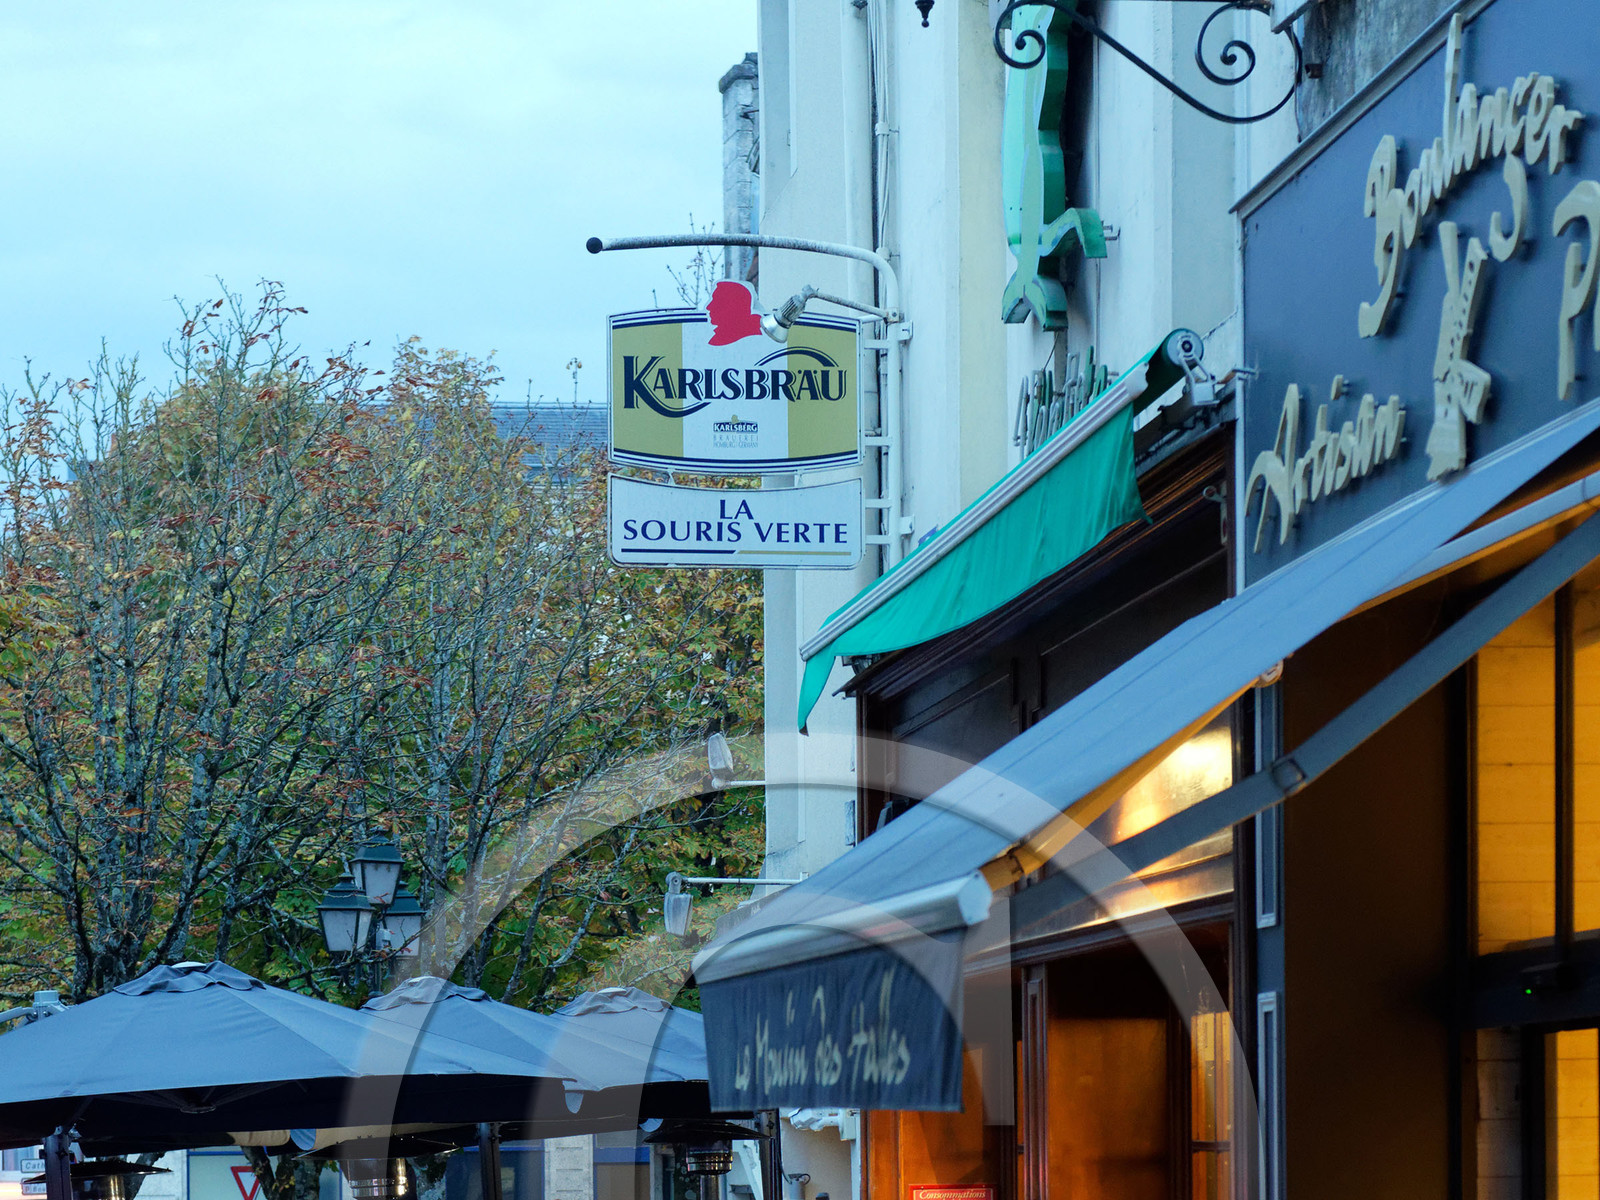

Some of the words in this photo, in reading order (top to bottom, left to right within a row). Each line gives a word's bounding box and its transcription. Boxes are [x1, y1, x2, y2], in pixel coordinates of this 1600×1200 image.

[1358, 12, 1583, 338] Boulanger
[623, 346, 848, 418] KARLSBRÄU
[714, 423, 758, 432] KARLSBERG
[1245, 373, 1406, 553] Artisan
[719, 499, 754, 519] LA
[623, 520, 742, 542] SOURIS
[754, 522, 848, 543] VERTE
[919, 1190, 986, 1200] Consommations
